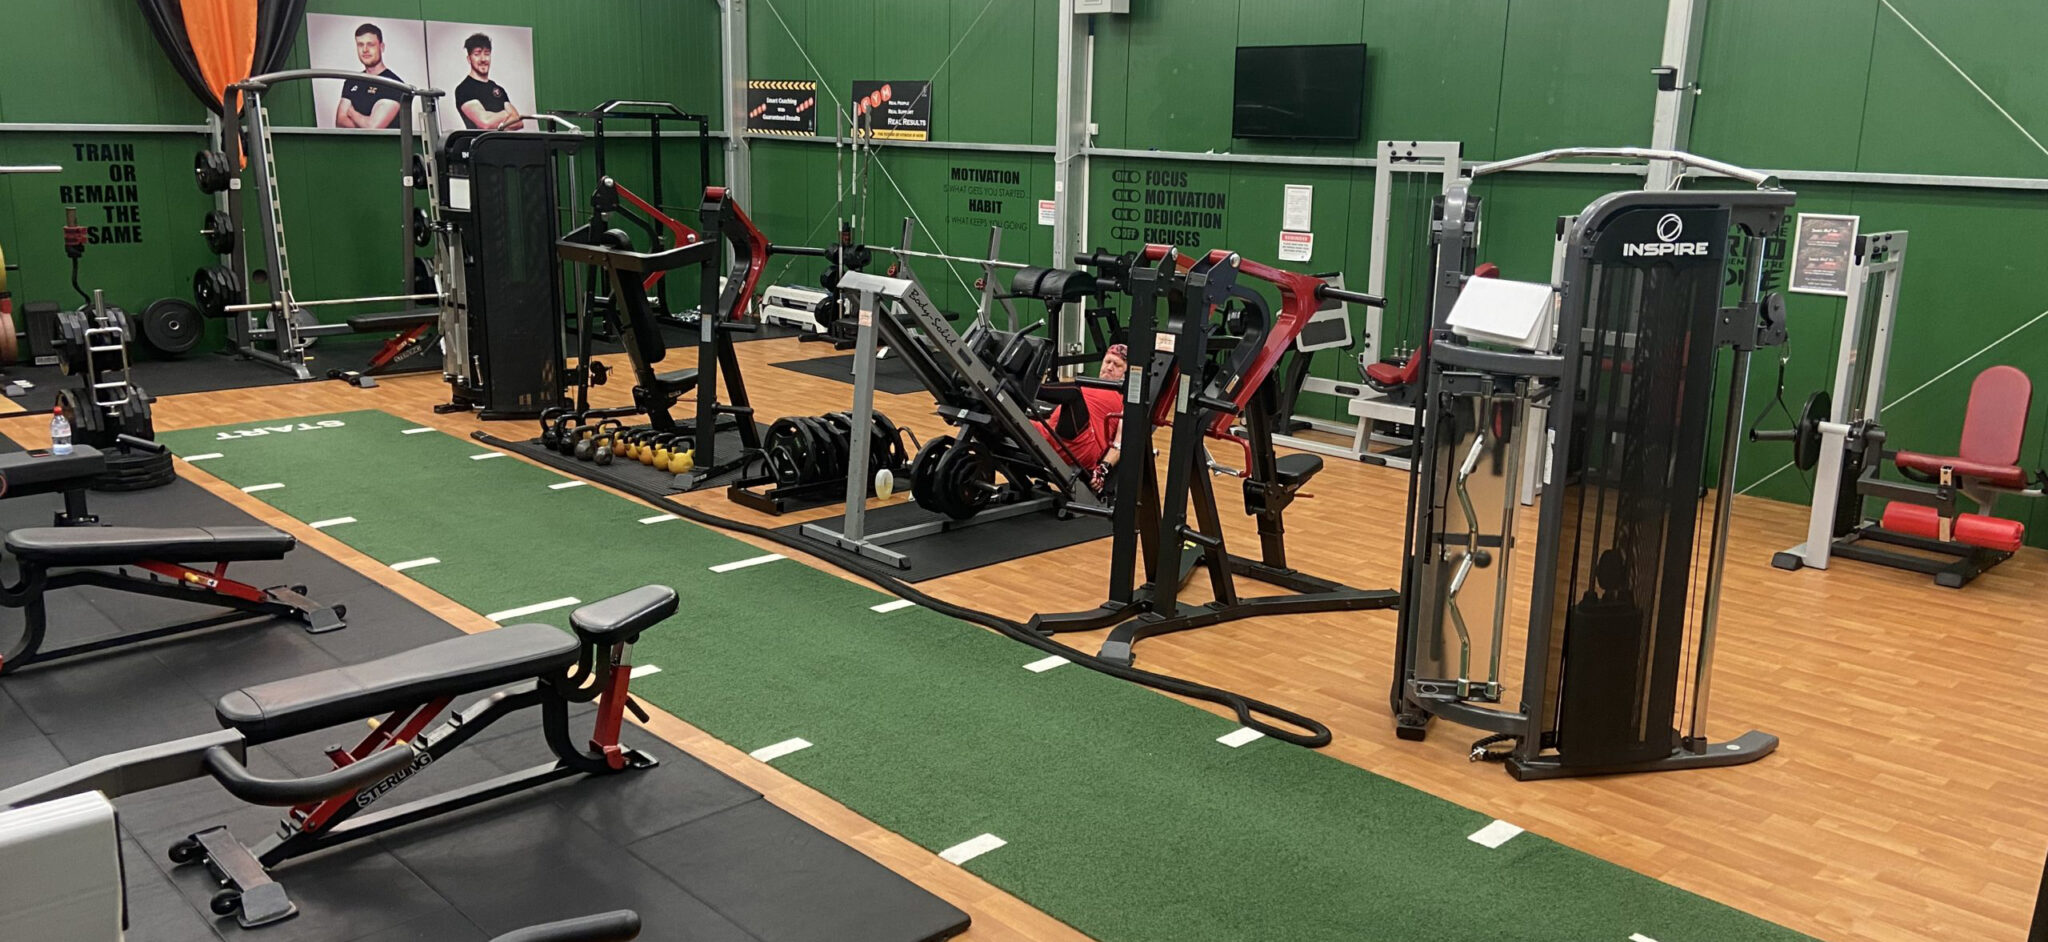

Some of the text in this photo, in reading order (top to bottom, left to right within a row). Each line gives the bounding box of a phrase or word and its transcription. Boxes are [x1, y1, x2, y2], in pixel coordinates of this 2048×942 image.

[888, 118, 927, 127] REAL RESULTS
[72, 143, 135, 162] TRAIN
[109, 164, 137, 182] OR
[951, 167, 1020, 185] MOTIVATION
[1145, 170, 1188, 188] FOCUS
[60, 185, 138, 203] REMAIN
[983, 187, 999, 197] YOU
[1144, 189, 1226, 209] MOTIVATION
[103, 205, 141, 223] THE
[968, 199, 1003, 214] HABIT
[1003, 221, 1028, 231] GOING
[1144, 209, 1222, 229] DEDICATION
[87, 226, 143, 245] SAME
[1143, 228, 1200, 247] EXCUSES
[1623, 242, 1709, 256] INSPIRE
[909, 288, 957, 347] Body-Solid
[216, 420, 345, 440] START
[356, 752, 433, 808] STERLING
